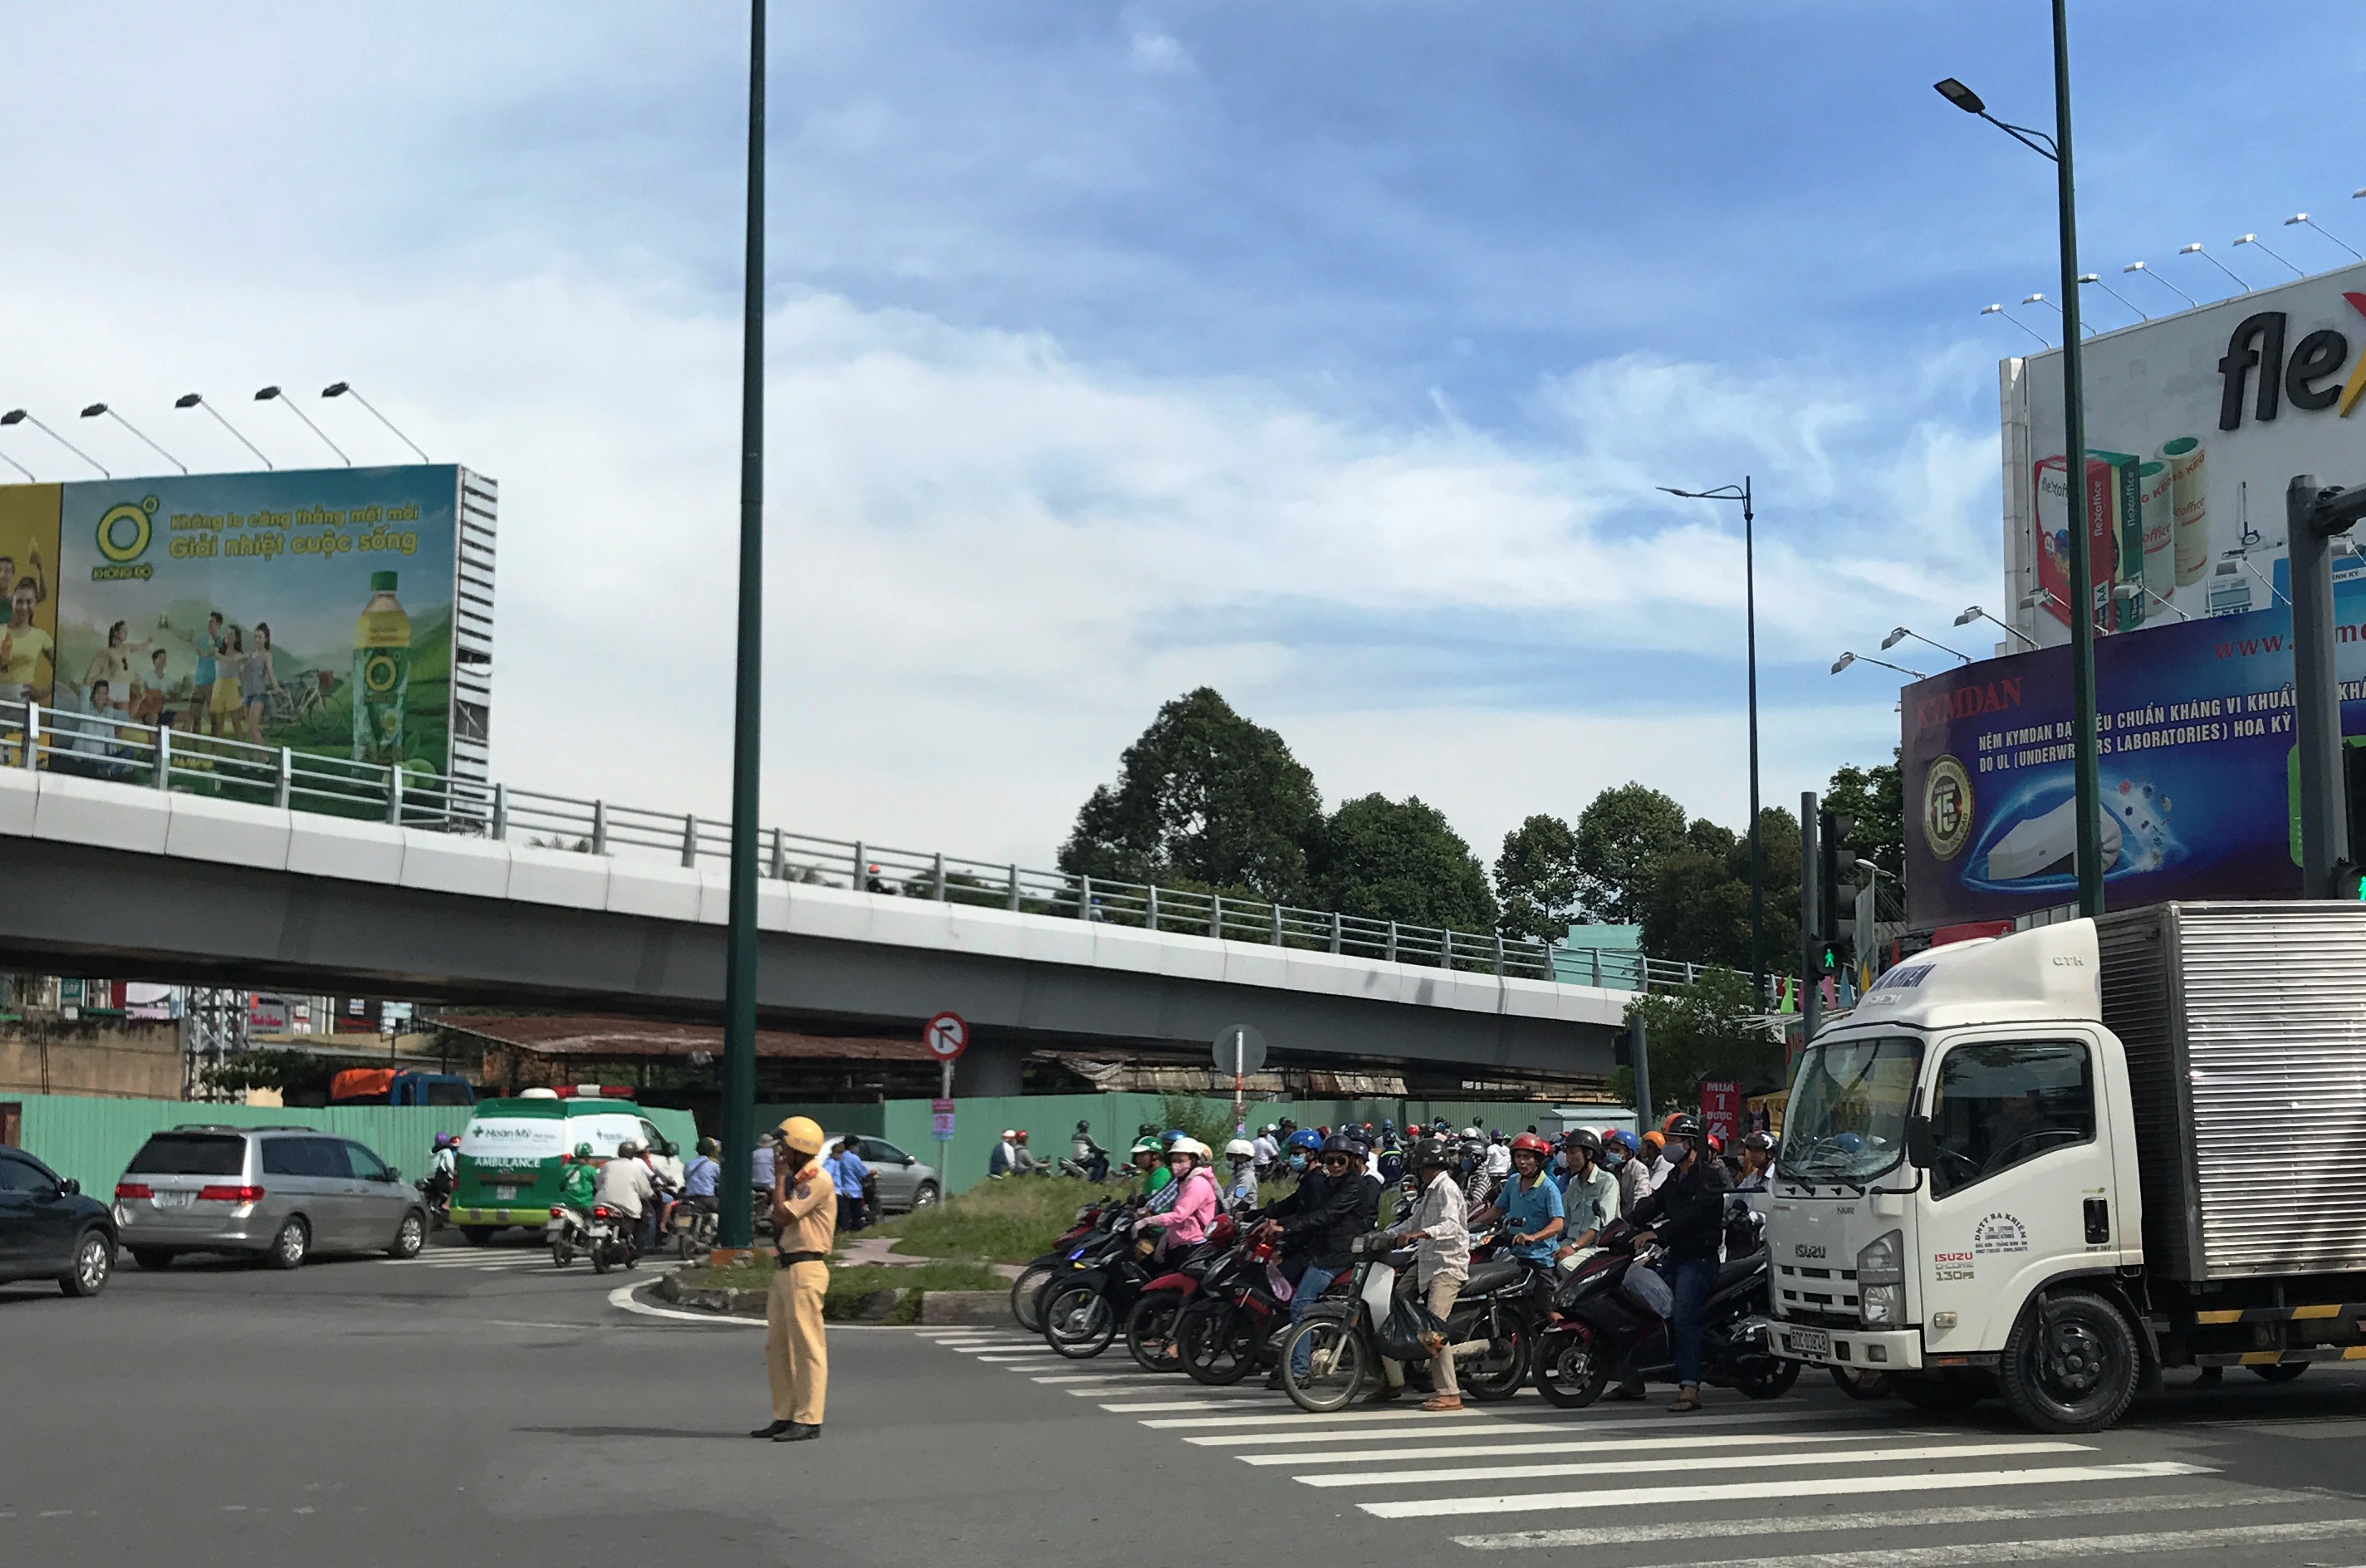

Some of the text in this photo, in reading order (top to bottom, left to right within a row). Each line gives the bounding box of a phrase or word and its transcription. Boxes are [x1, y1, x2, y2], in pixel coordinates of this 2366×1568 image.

[169, 523, 418, 561] Giải nhiệt cuộc sống
[1916, 677, 2024, 729] KYMDAN
[1978, 732, 2002, 753] NỆM
[2006, 724, 2053, 747] KYMDAN
[2056, 720, 2075, 741] ĐẠ
[2117, 701, 2165, 729] CHUẨN
[2170, 699, 2221, 722] KHÁNG
[2226, 696, 2241, 716] VI
[1979, 756, 1992, 773] DO
[1996, 753, 2011, 770] UL
[2234, 717, 2266, 737] HOA
[2271, 711, 2292, 733] KỲ
[1706, 1082, 1735, 1092] MUA
[1715, 1093, 1726, 1110] 1
[1708, 1122, 1729, 1140] 4
[474, 1156, 541, 1169] AMBULANCE
[1795, 1244, 1826, 1259] ISUZU
[1934, 1252, 1973, 1262] ISUZU
